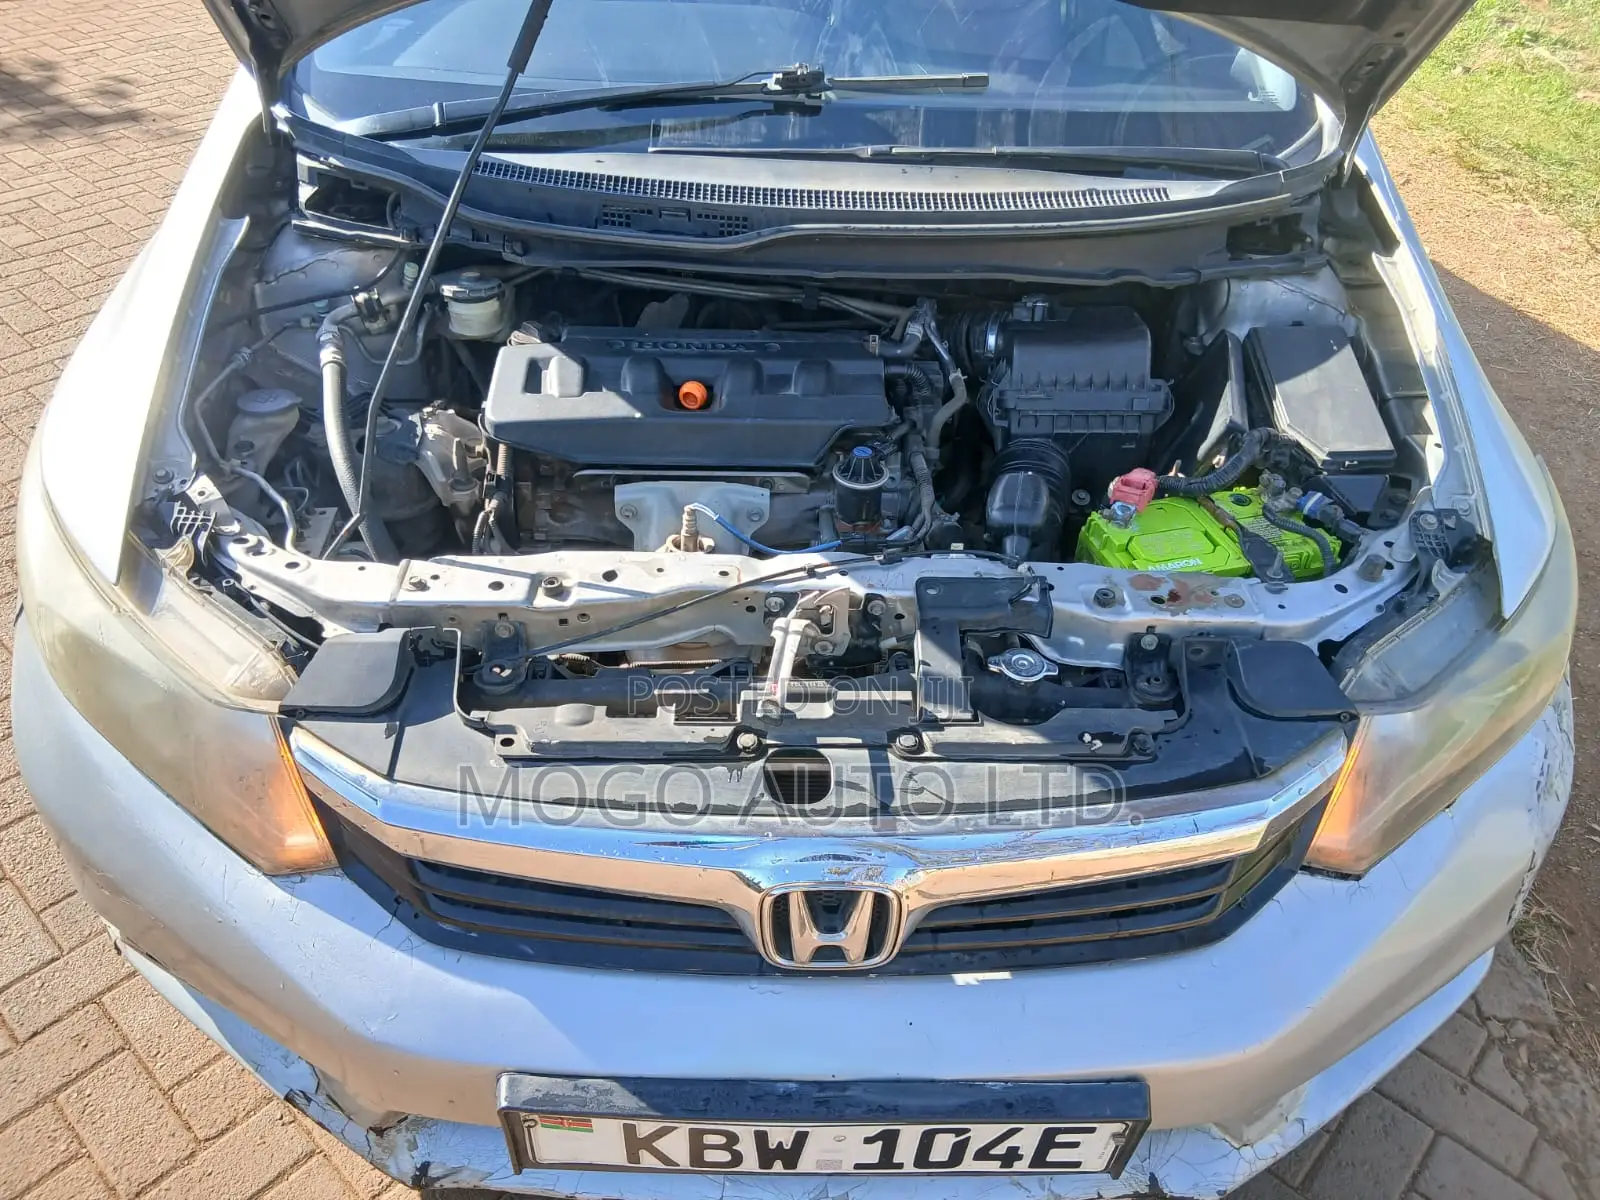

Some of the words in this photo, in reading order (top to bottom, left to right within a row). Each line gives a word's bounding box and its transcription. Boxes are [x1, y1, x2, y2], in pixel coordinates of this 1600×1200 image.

[632, 340, 756, 353] HONDA
[1147, 557, 1203, 572] AMARON
[621, 1122, 811, 1170] KBW
[852, 1125, 1097, 1171] 104E
